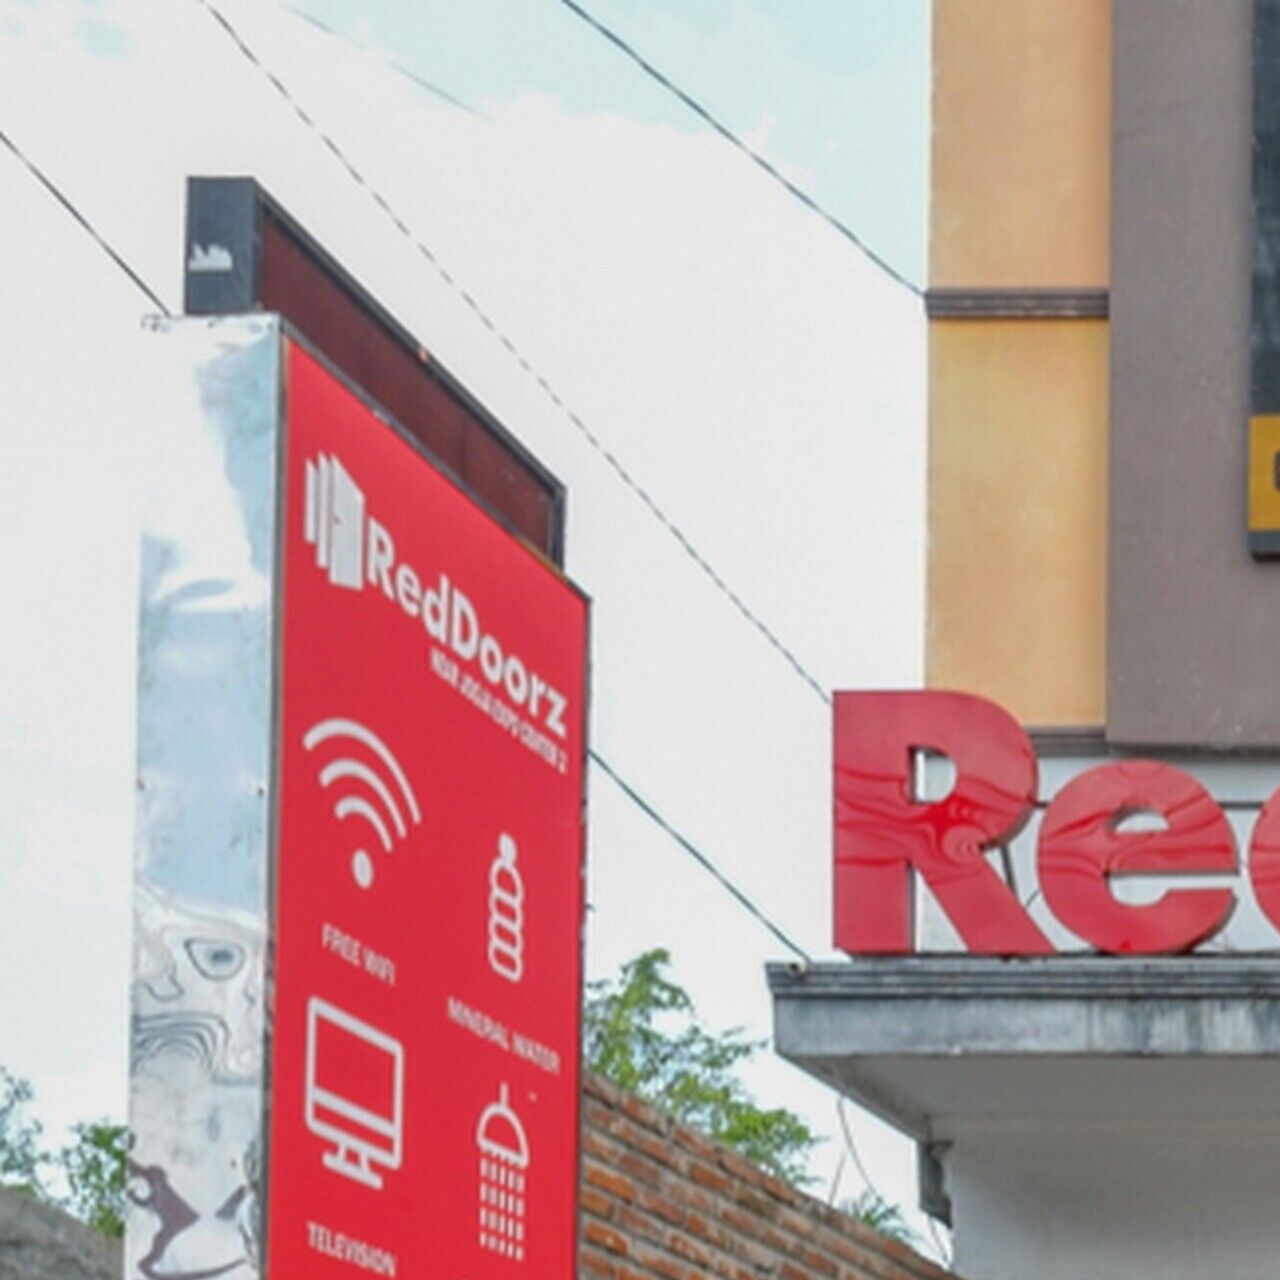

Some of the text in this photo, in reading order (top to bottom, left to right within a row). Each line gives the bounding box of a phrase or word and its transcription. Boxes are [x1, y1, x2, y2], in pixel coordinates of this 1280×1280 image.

[367, 516, 569, 739] RedDoorz
[321, 921, 396, 986] FREE WIFI
[447, 994, 561, 1076] MINERAL WATER
[306, 1219, 397, 1280] TELEVISION
